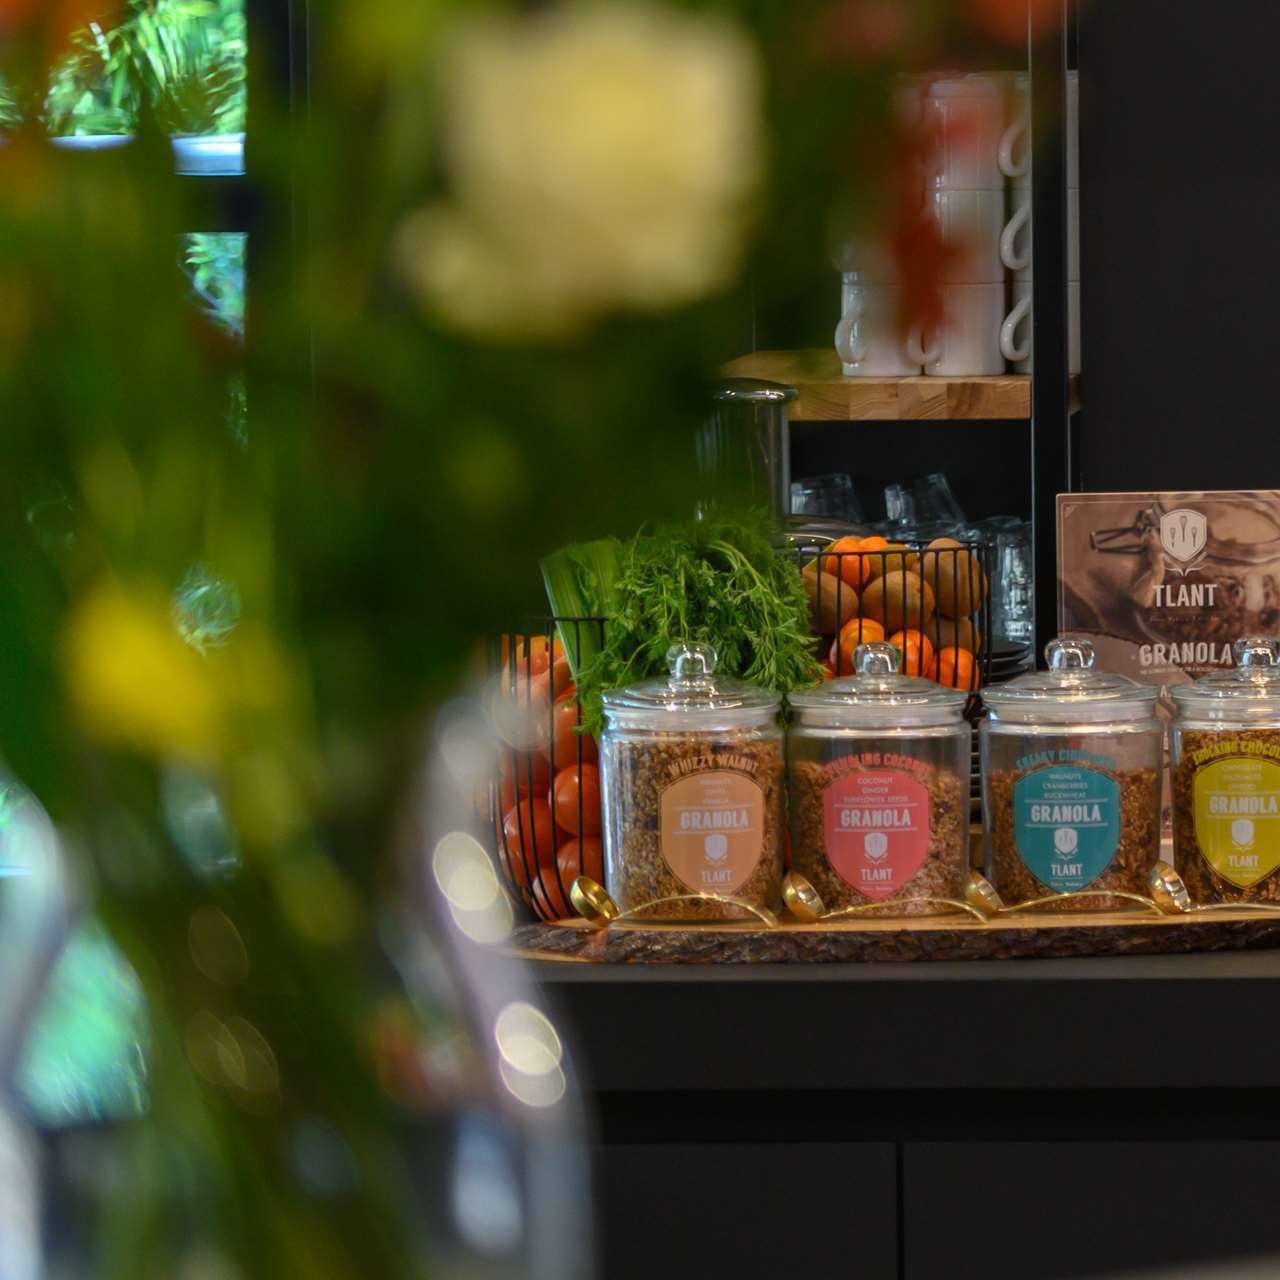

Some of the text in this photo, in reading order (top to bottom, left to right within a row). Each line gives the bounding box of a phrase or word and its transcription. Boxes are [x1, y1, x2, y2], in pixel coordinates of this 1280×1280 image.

[1152, 584, 1217, 607] TLANT
[1139, 642, 1232, 666] GRANOLA
[668, 754, 759, 777] WHIZZY WALNUT
[1031, 805, 1101, 822] GRANOLA
[1209, 796, 1278, 814] GRANOLA
[680, 809, 749, 829] GRANOLA
[841, 808, 911, 827] GRANOLA
[1050, 864, 1083, 876] TLANT
[1228, 856, 1259, 866] TLANT
[702, 870, 733, 882] TLANT
[860, 868, 893, 881] TLANT
